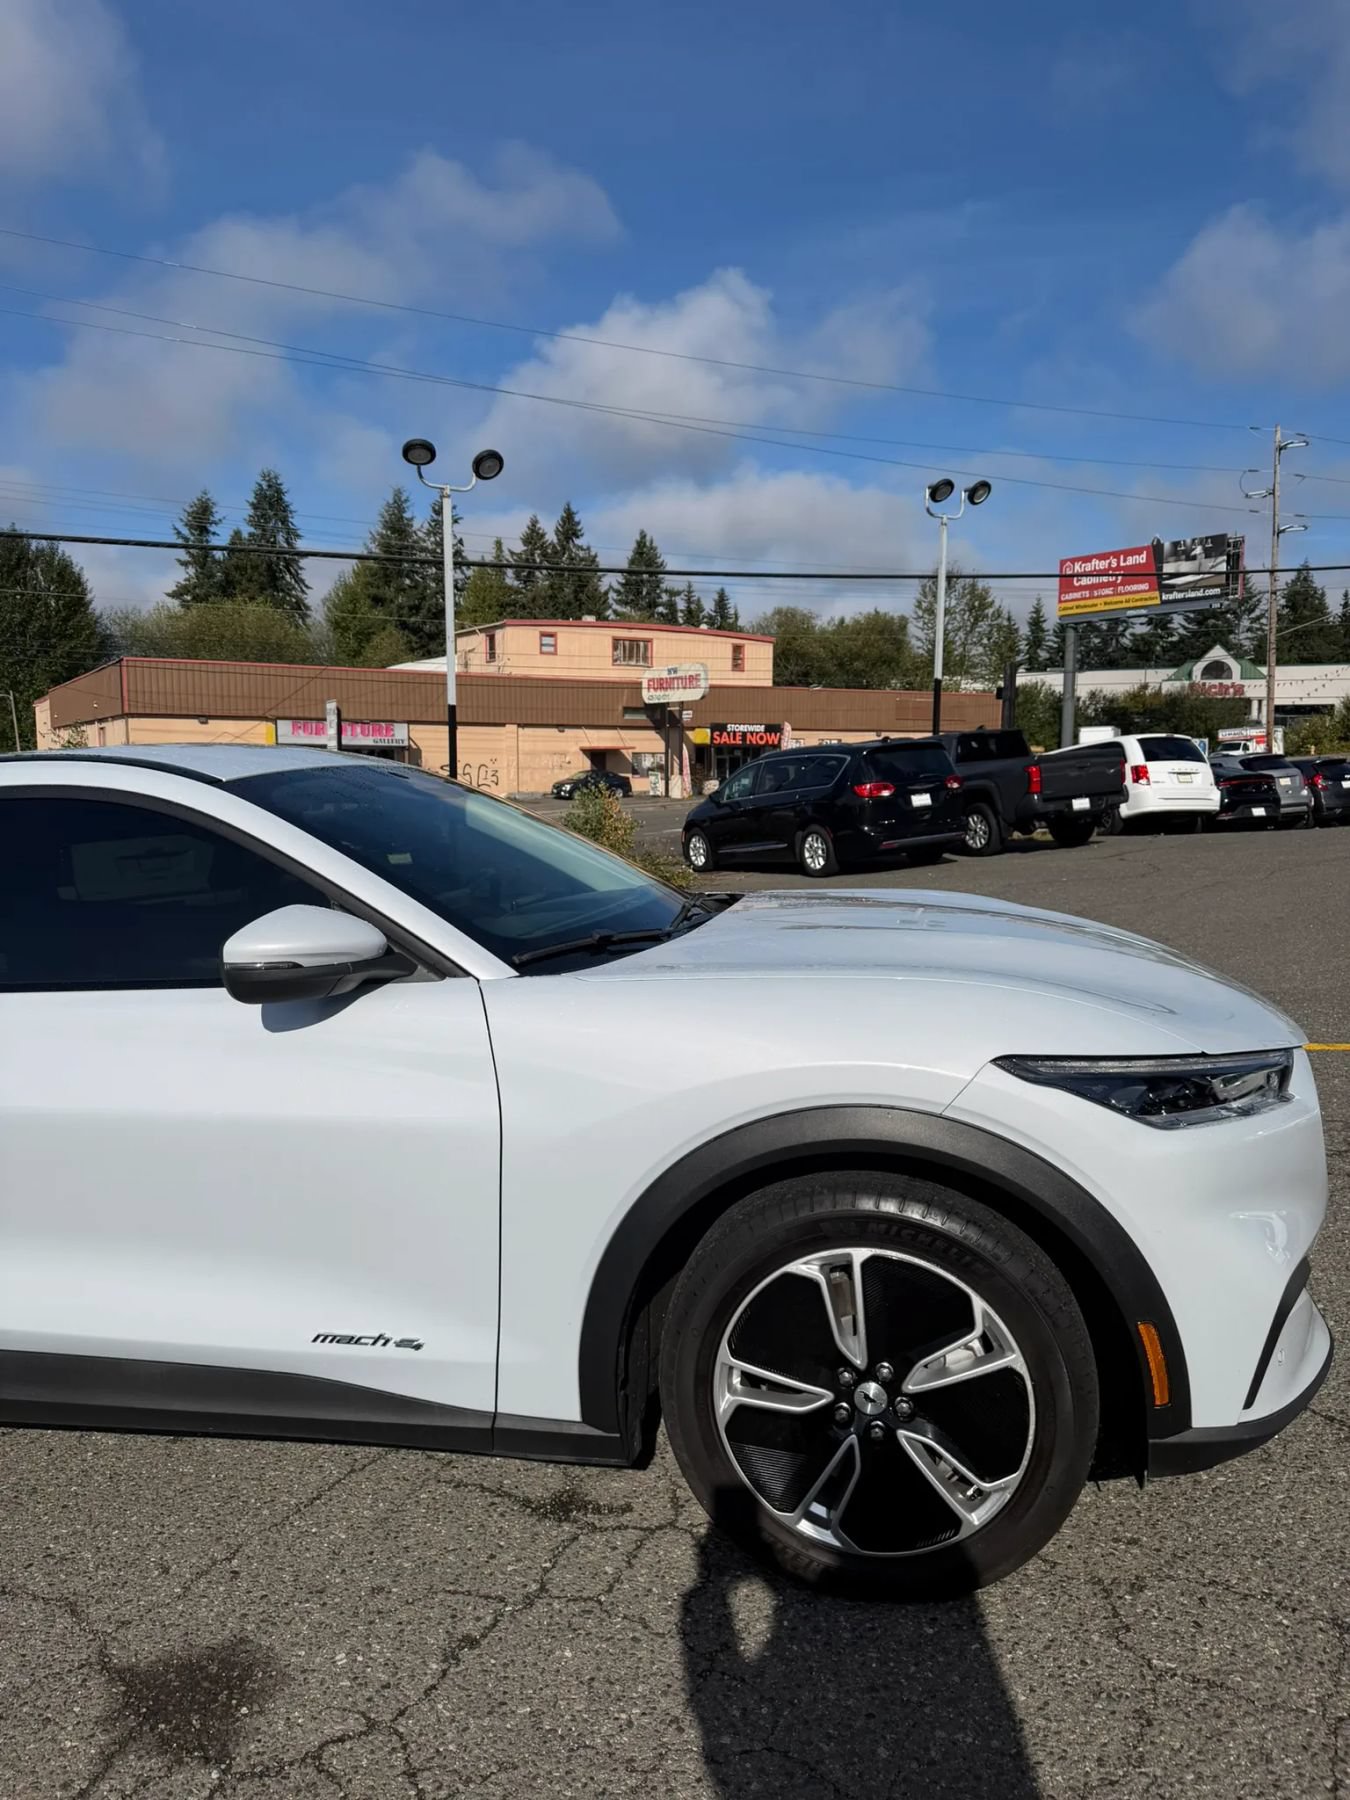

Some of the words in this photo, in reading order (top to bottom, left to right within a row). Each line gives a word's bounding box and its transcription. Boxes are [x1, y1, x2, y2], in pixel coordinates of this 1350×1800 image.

[1074, 557, 1117, 574] Krafter's
[1120, 550, 1147, 566] Land
[1073, 569, 1124, 587] Cabinetry
[1117, 583, 1150, 593] FLOORING
[1161, 587, 1221, 601] kraftersland.com
[647, 673, 701, 692] FURNITURE
[291, 720, 395, 737] FURITURE
[726, 723, 766, 732] STOREWIDE
[713, 731, 743, 745] SALE
[746, 732, 781, 745] NOW
